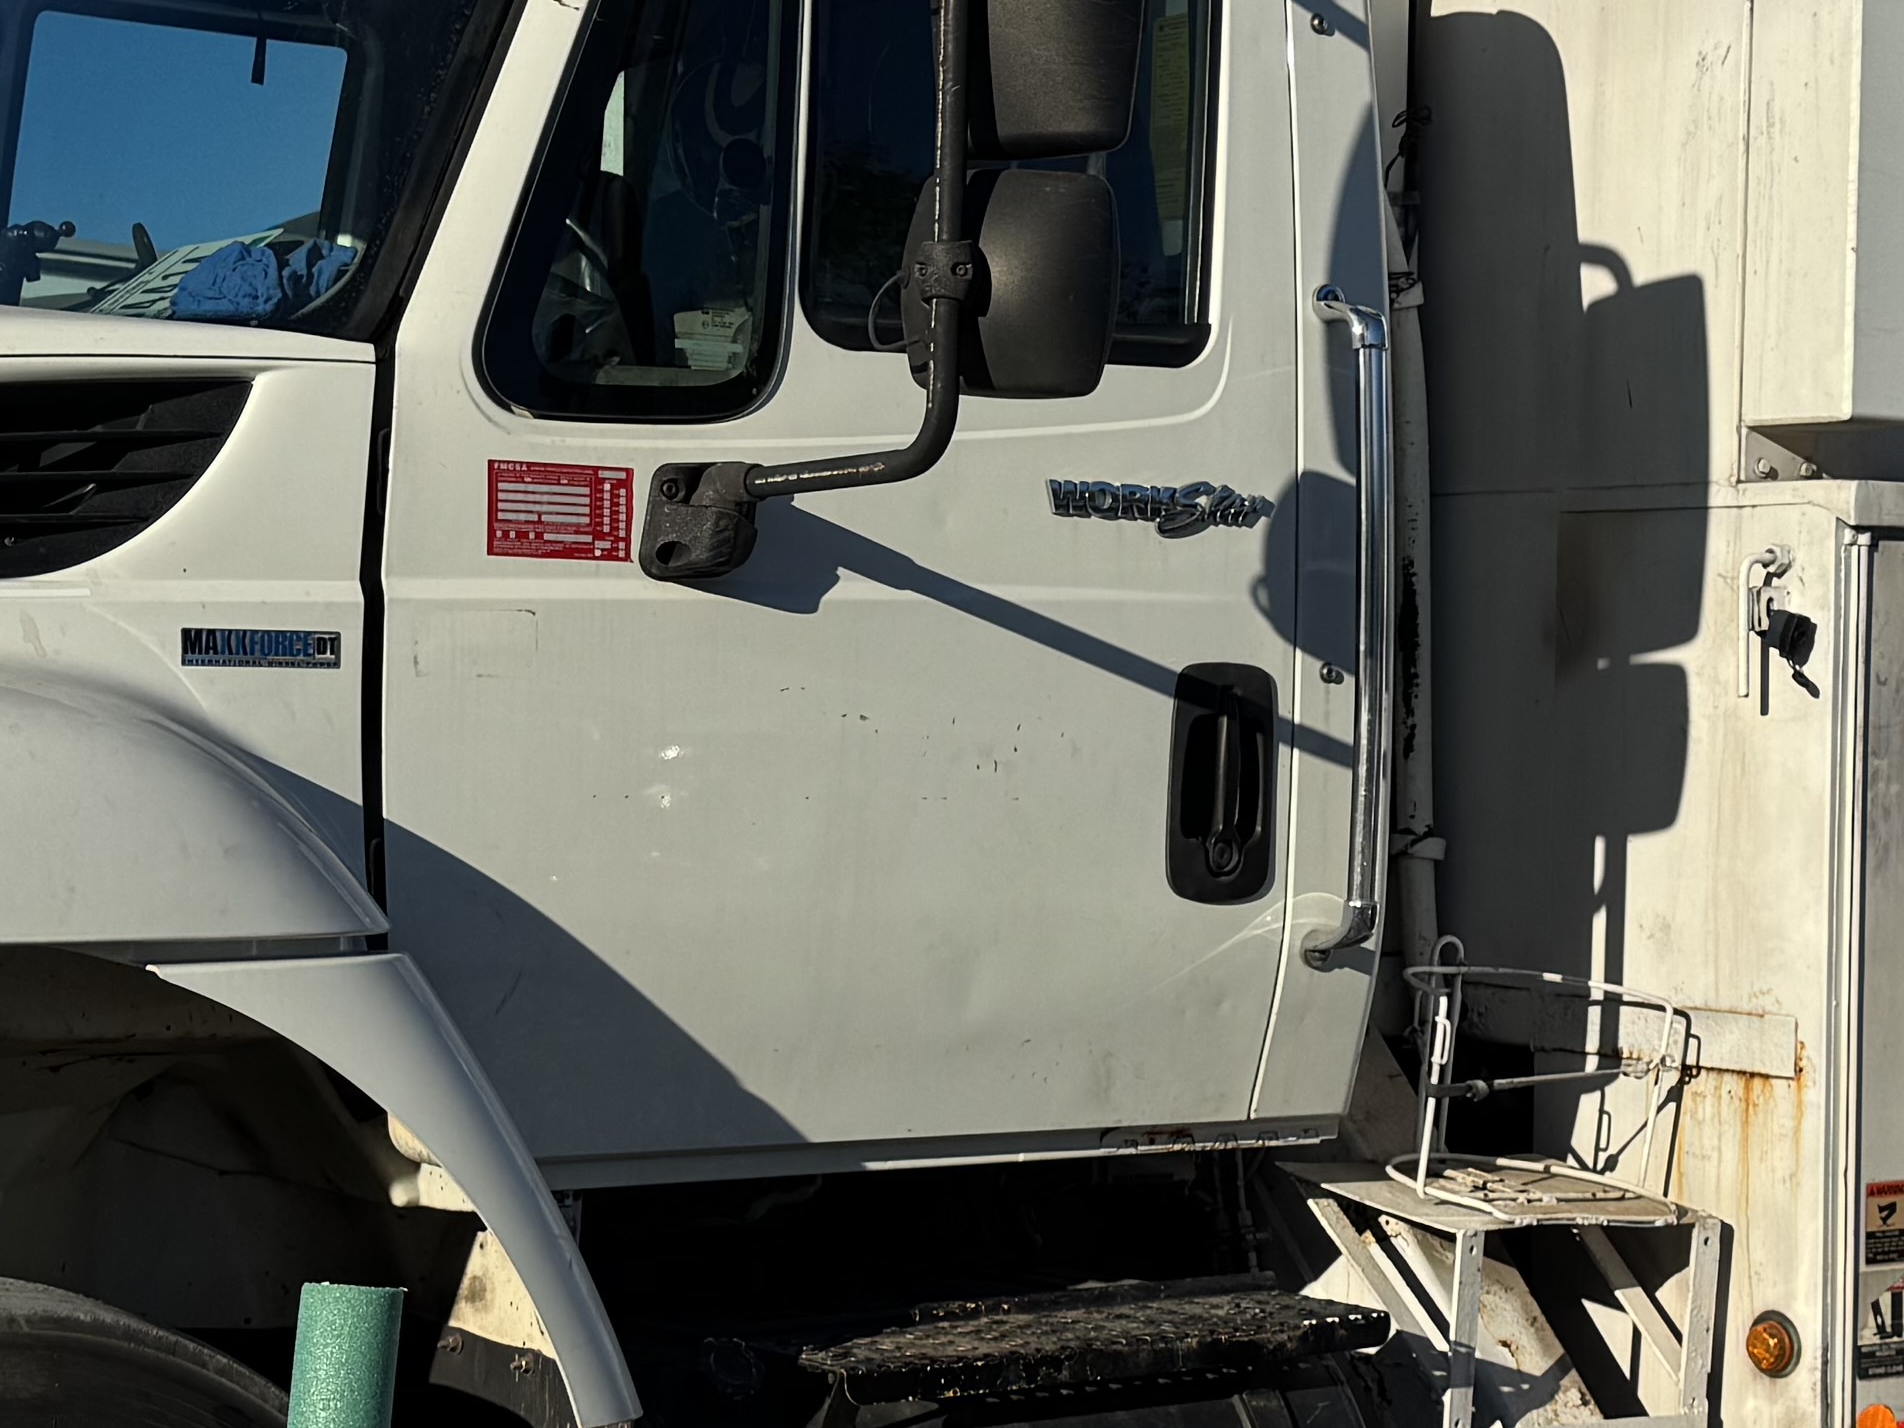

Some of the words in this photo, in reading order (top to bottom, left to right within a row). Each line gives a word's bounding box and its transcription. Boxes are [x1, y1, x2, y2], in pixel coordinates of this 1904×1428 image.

[493, 462, 528, 472] FMCSA
[182, 628, 314, 658] MAXXFORCE
[316, 636, 338, 656] DT
